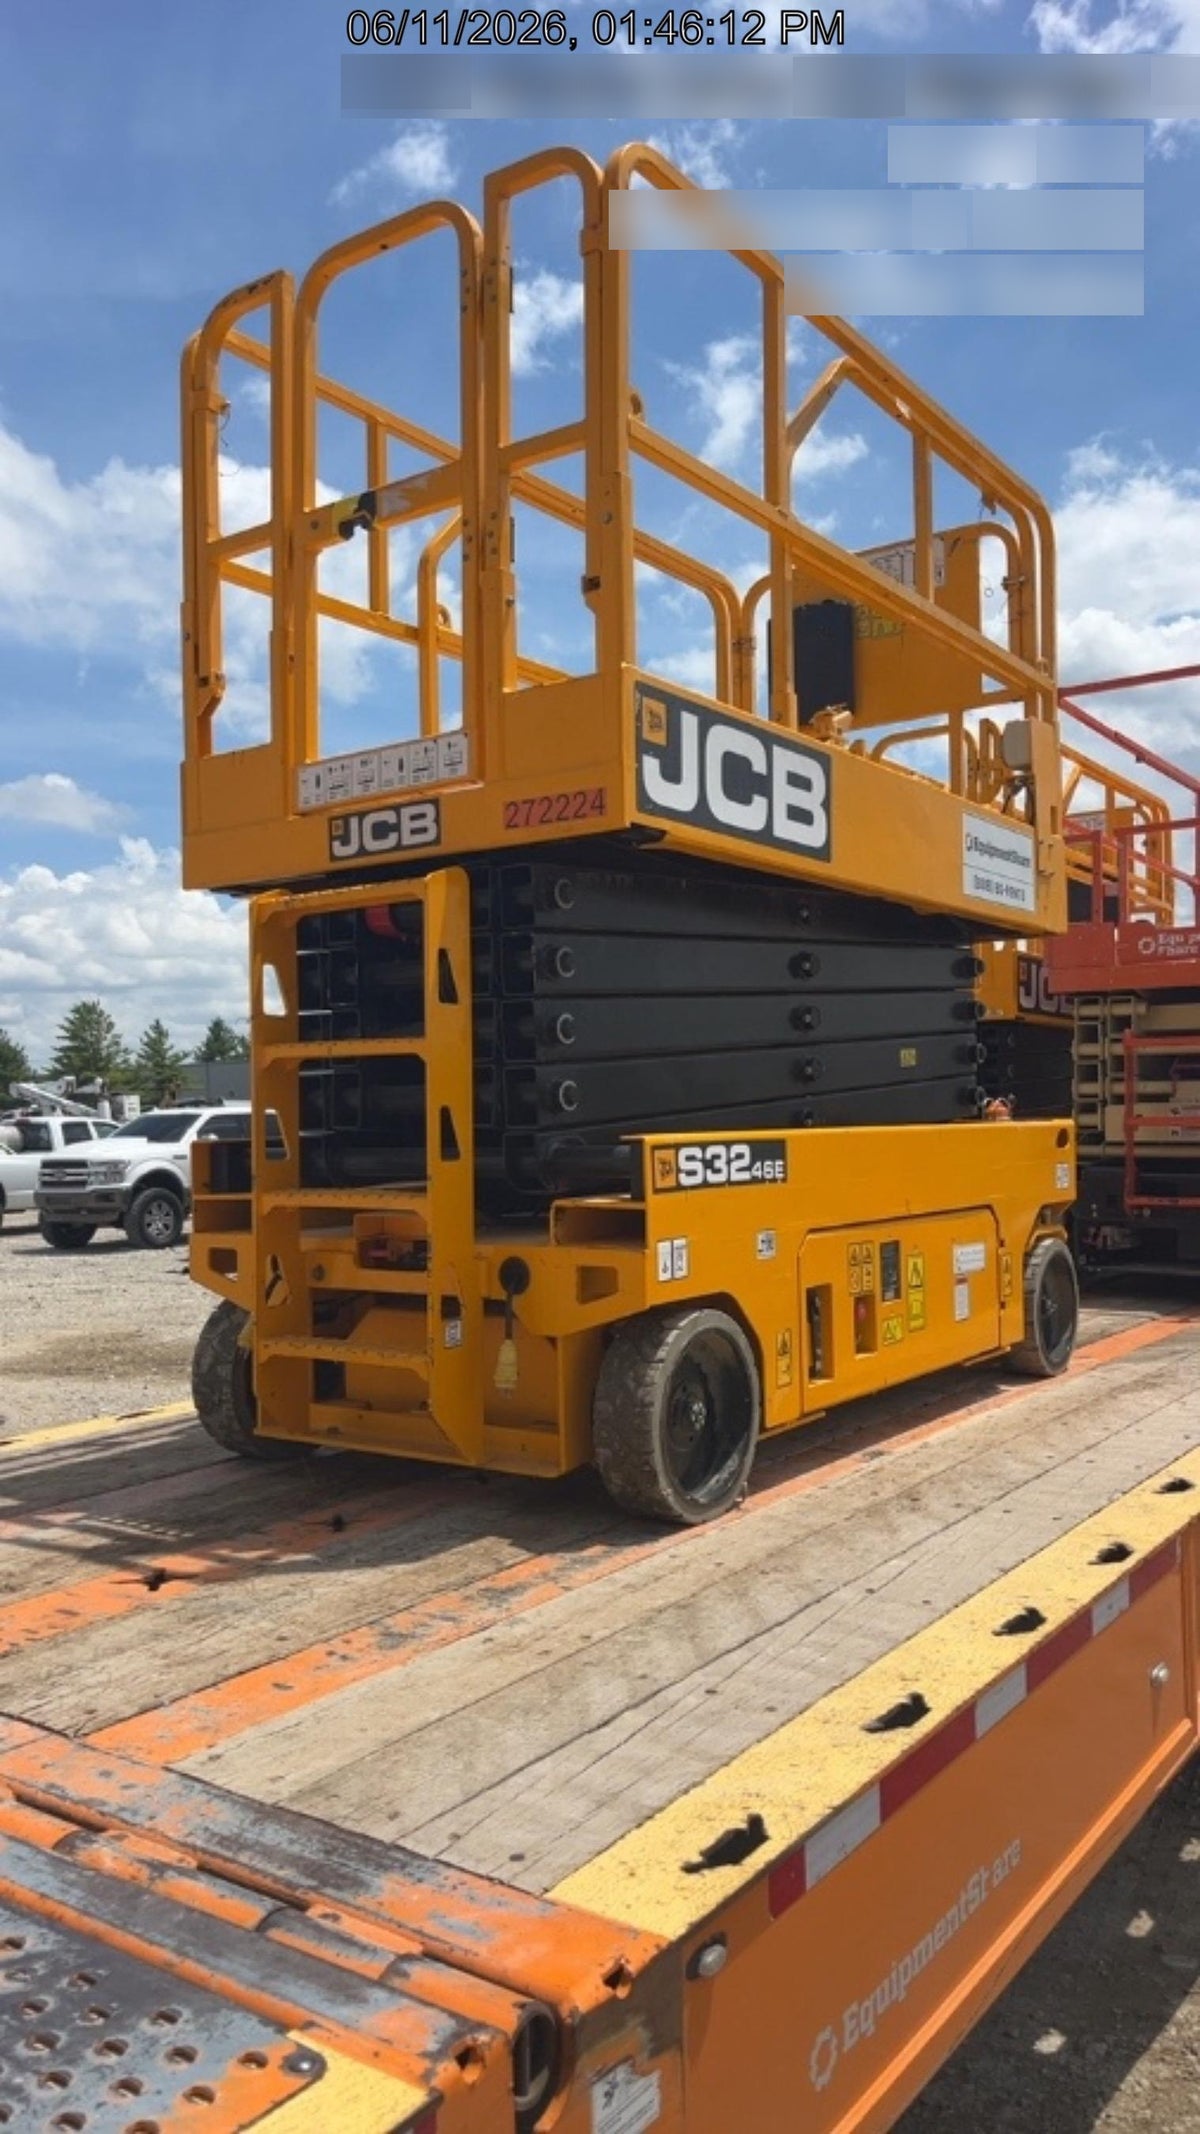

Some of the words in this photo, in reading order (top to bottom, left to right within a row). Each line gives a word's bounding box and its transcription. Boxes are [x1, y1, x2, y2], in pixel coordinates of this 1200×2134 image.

[641, 709, 828, 850] JCB
[331, 802, 438, 858] JCB
[504, 787, 607, 830] 272224
[1019, 960, 1075, 1014] JC
